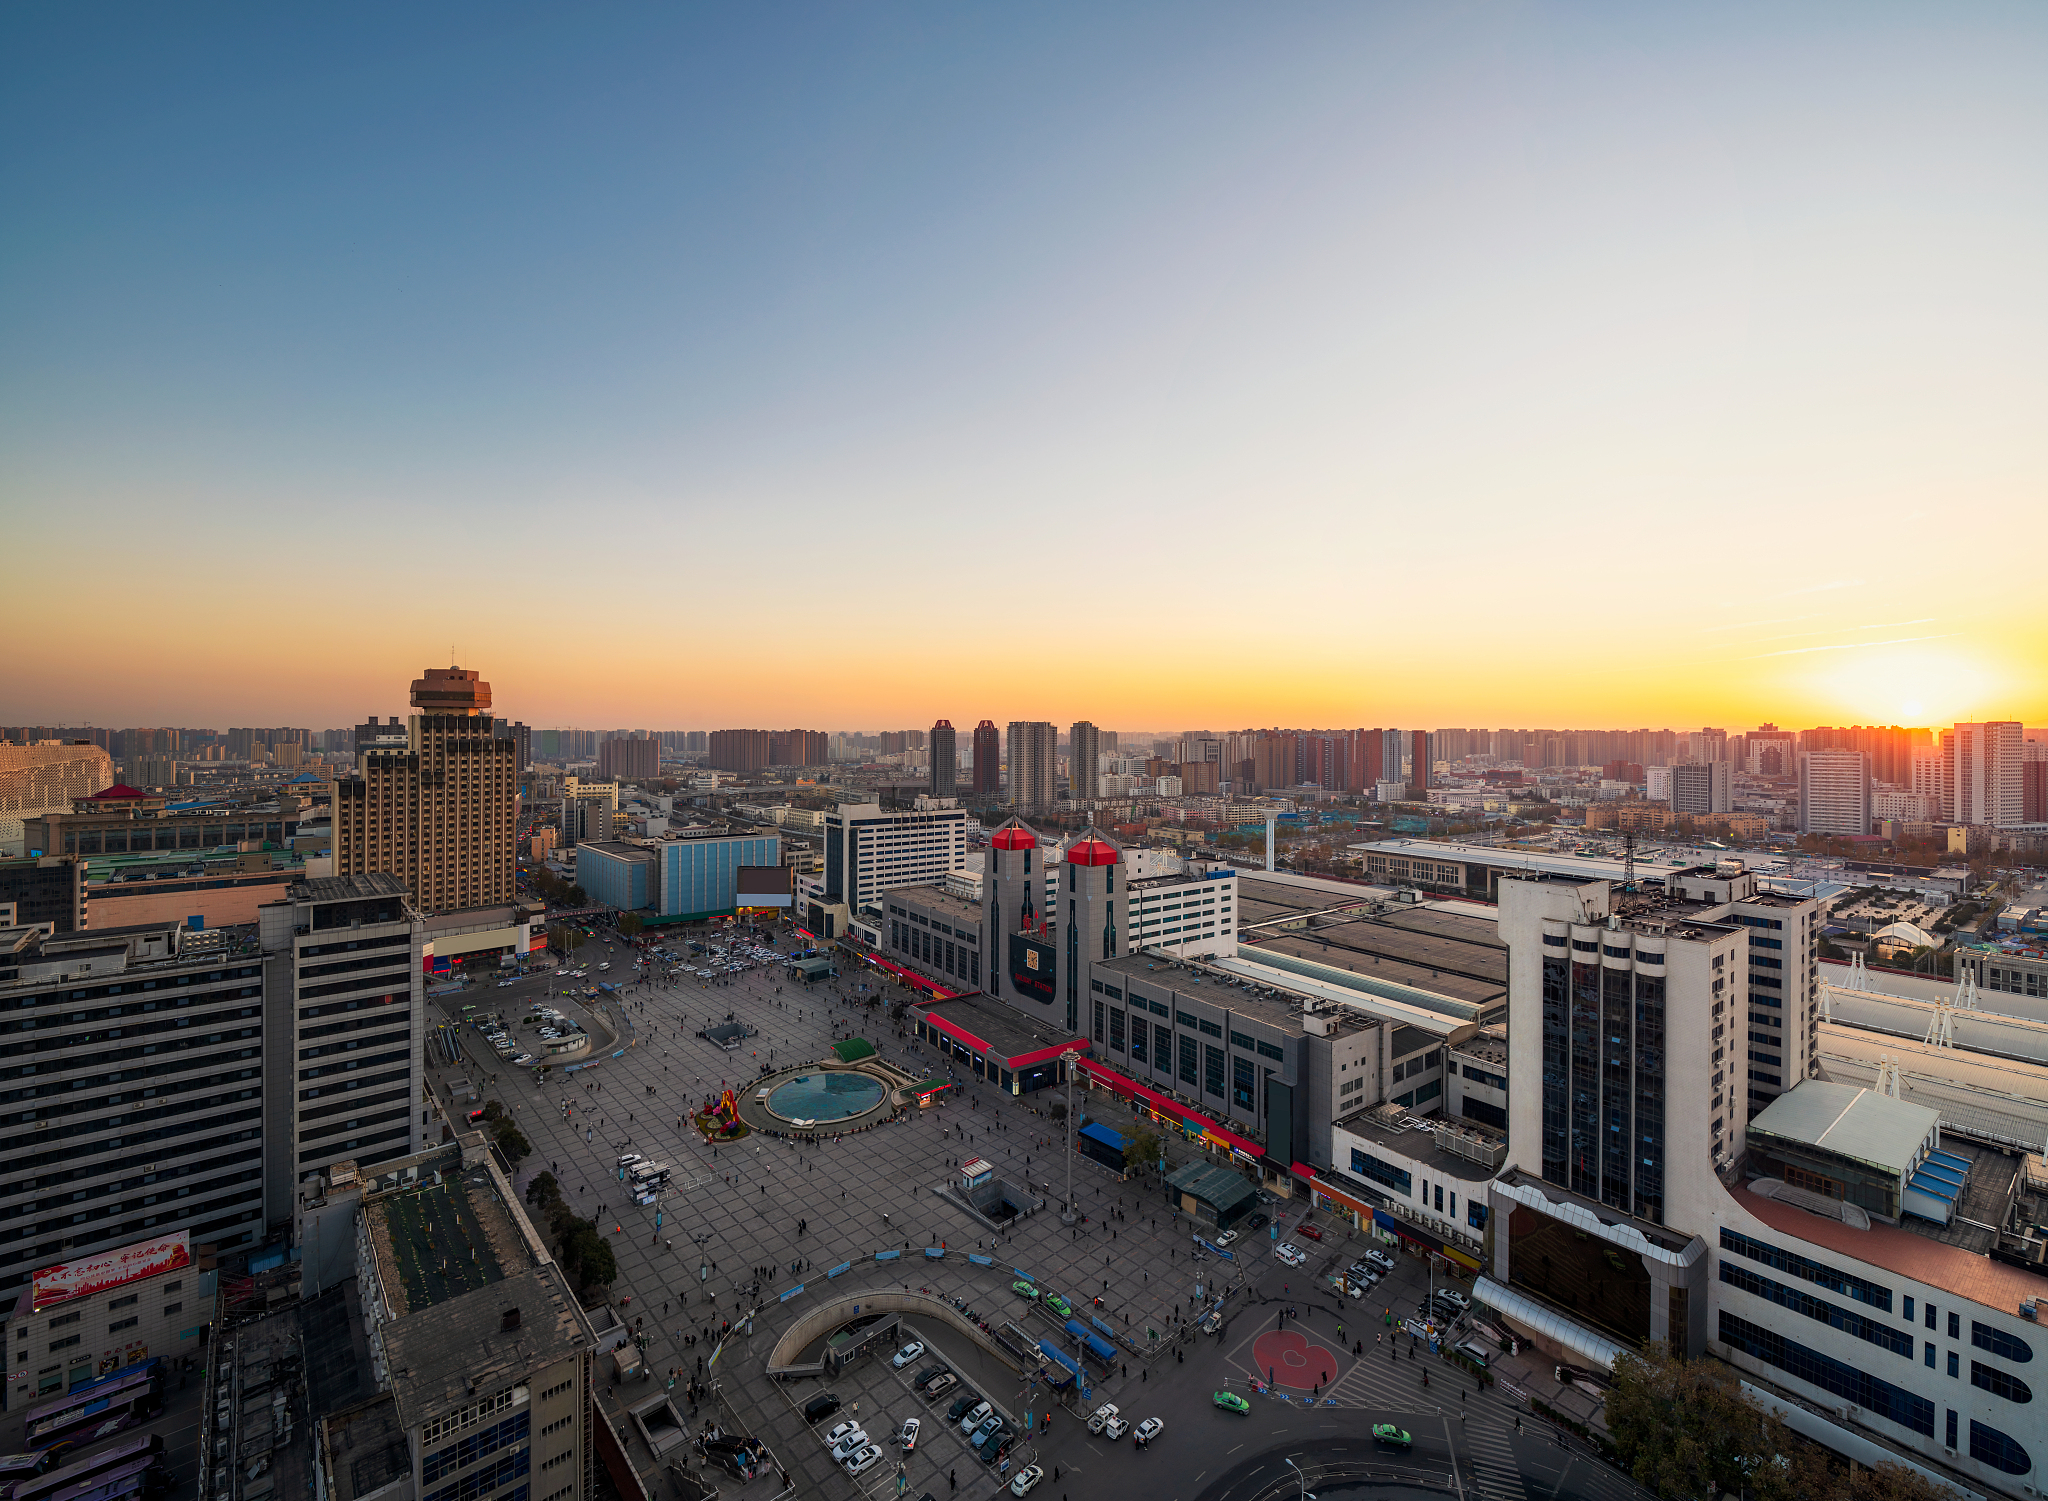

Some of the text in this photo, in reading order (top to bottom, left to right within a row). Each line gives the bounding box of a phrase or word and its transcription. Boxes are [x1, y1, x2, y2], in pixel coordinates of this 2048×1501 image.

[1014, 973, 1053, 994] RAILWAY STATION
[60, 1260, 113, 1280] 不忘初心
[120, 1243, 170, 1263] 牢记使命
